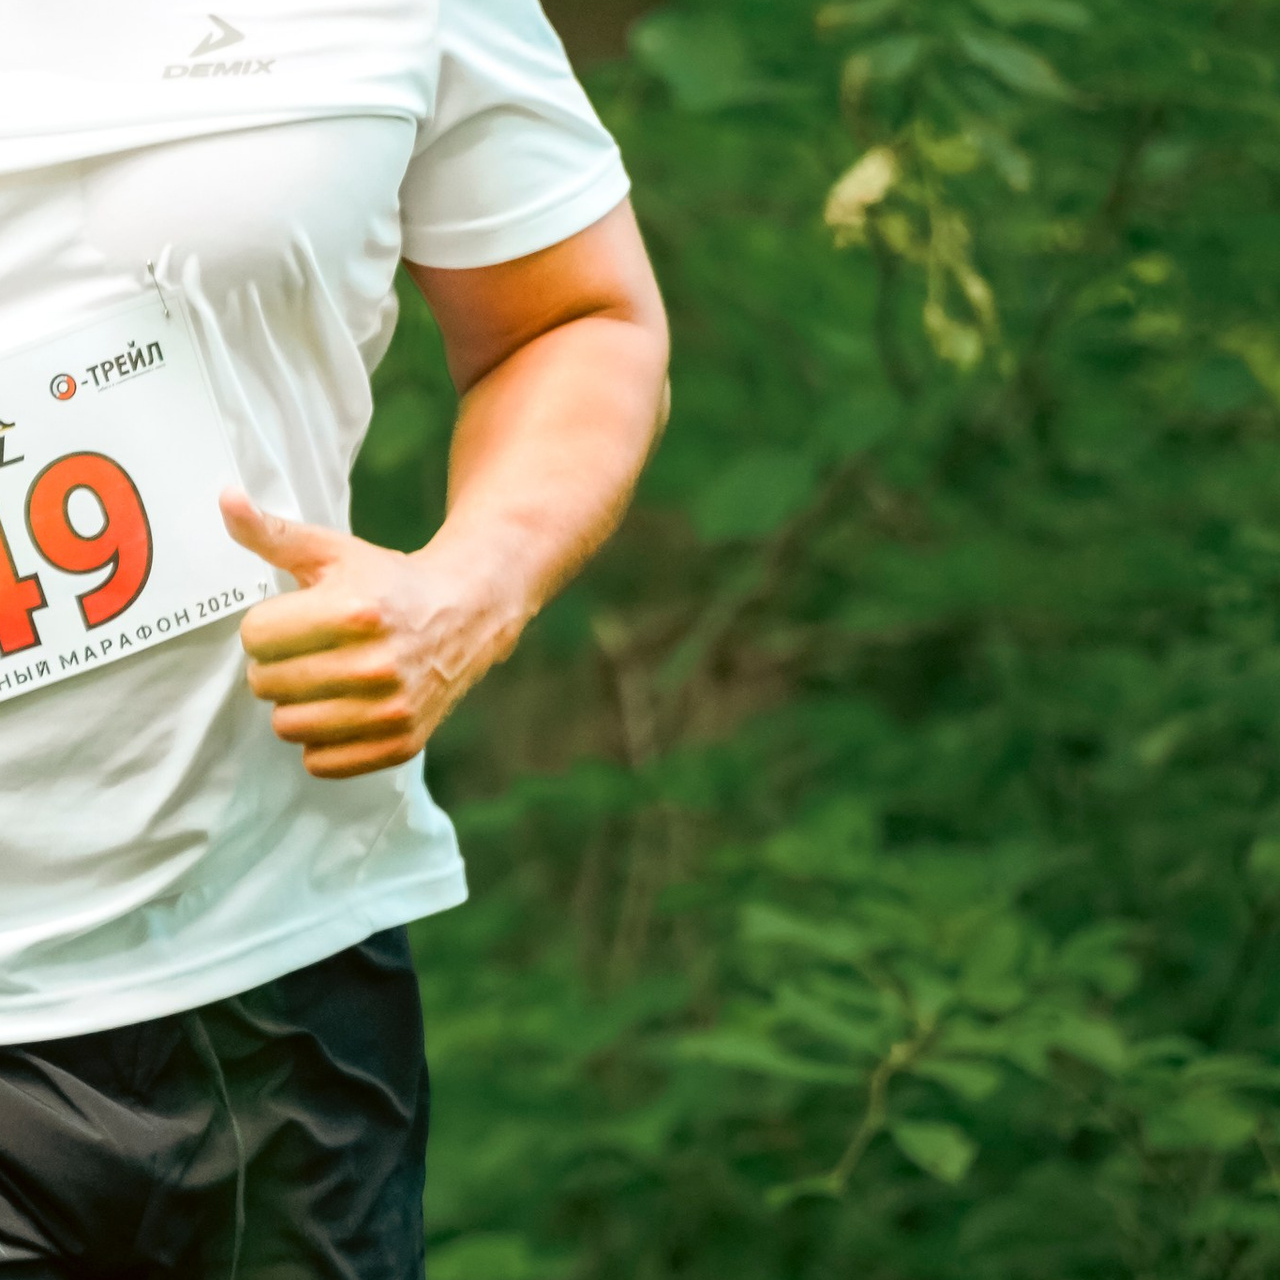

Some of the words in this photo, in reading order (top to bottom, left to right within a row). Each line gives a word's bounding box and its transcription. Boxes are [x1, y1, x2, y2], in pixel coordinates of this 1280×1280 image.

[162, 59, 276, 79] DEMIX
[58, 608, 190, 670] МАРАФОН
[196, 587, 245, 618] 2026
